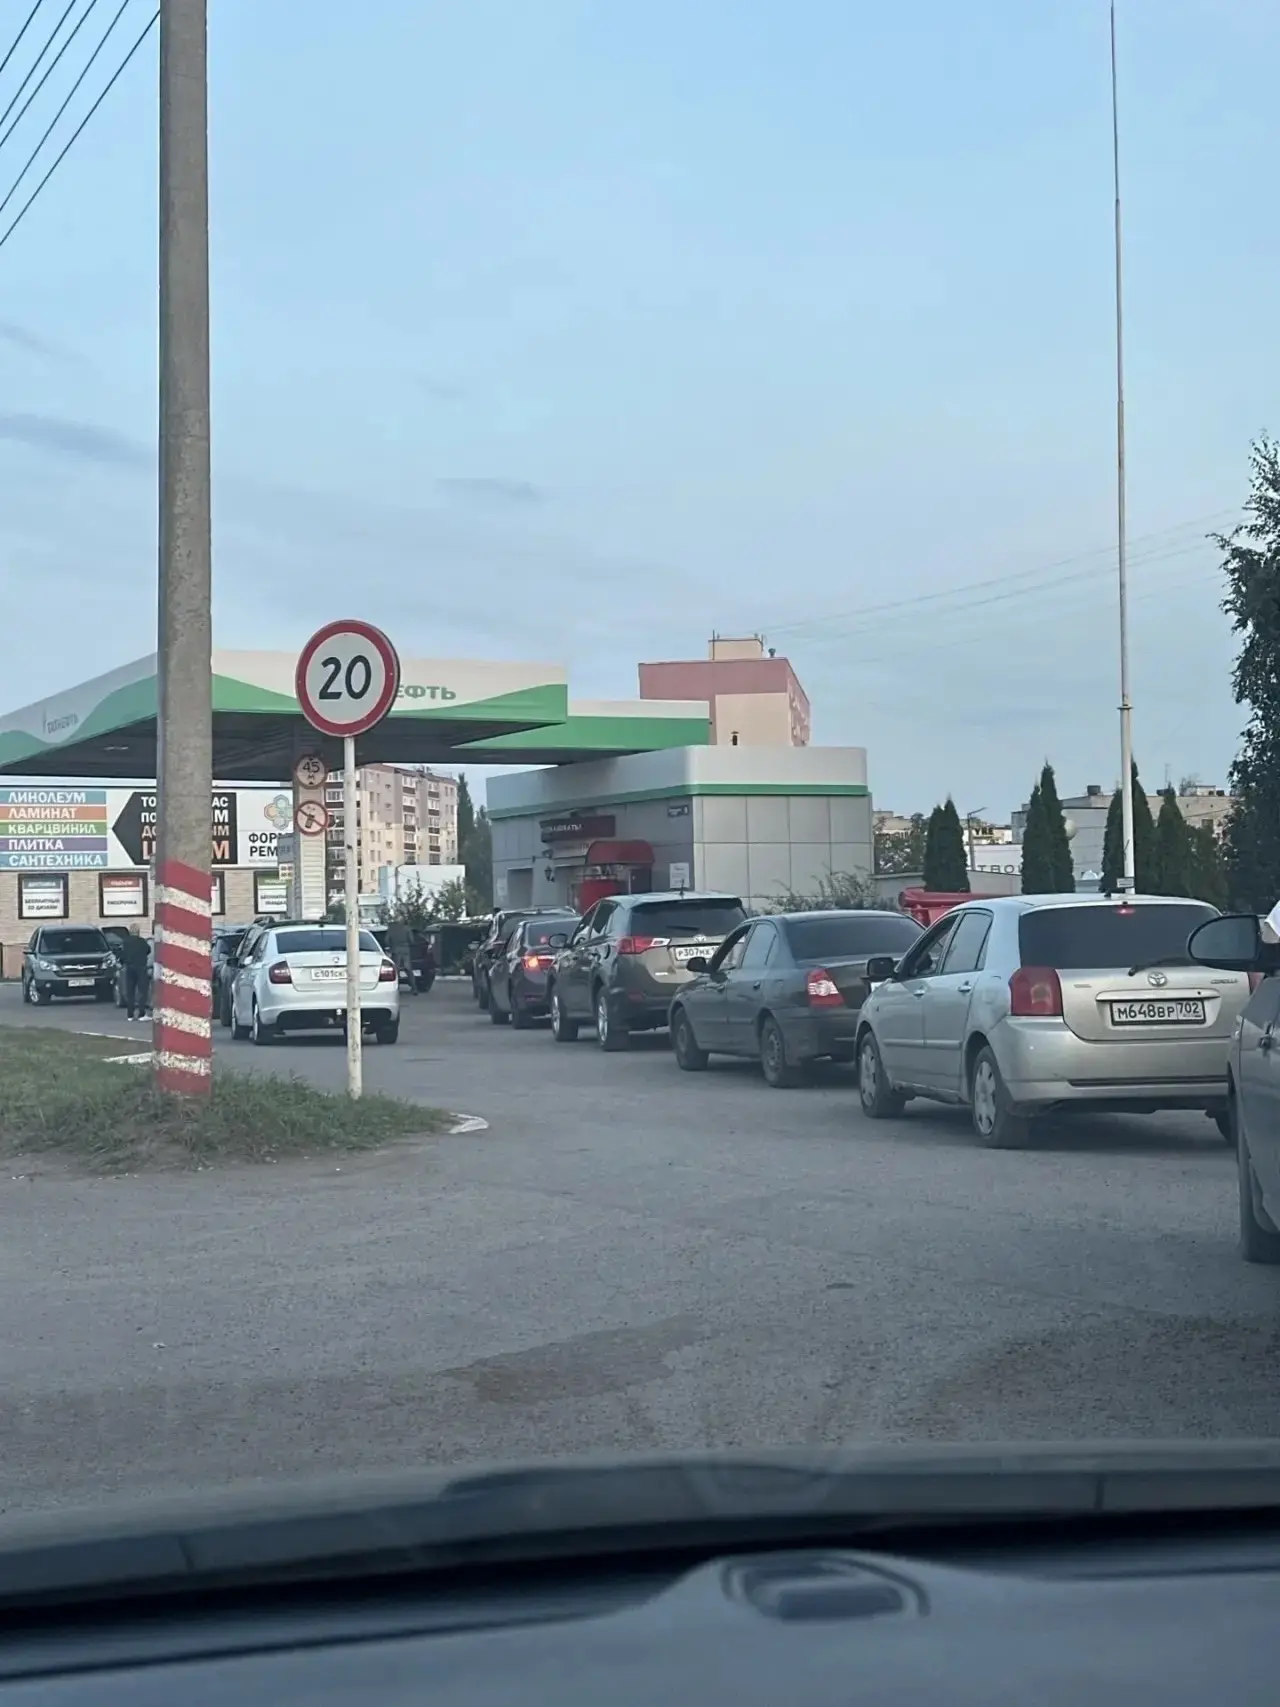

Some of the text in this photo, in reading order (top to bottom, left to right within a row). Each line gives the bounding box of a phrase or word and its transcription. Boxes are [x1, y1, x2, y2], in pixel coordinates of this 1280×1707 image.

[318, 655, 372, 700] 20
[397, 685, 457, 700] ЕФТЬ
[8, 791, 86, 804] ЛИНОЛЕУМ
[8, 807, 77, 819] ЛАМИНАТ
[8, 823, 97, 836] КВАРЦВИНИЛ
[8, 839, 64, 851] ПЛИТКА
[9, 854, 104, 867] САНТЕХНИКА
[1117, 1002, 1200, 1019] М648ВР 702
